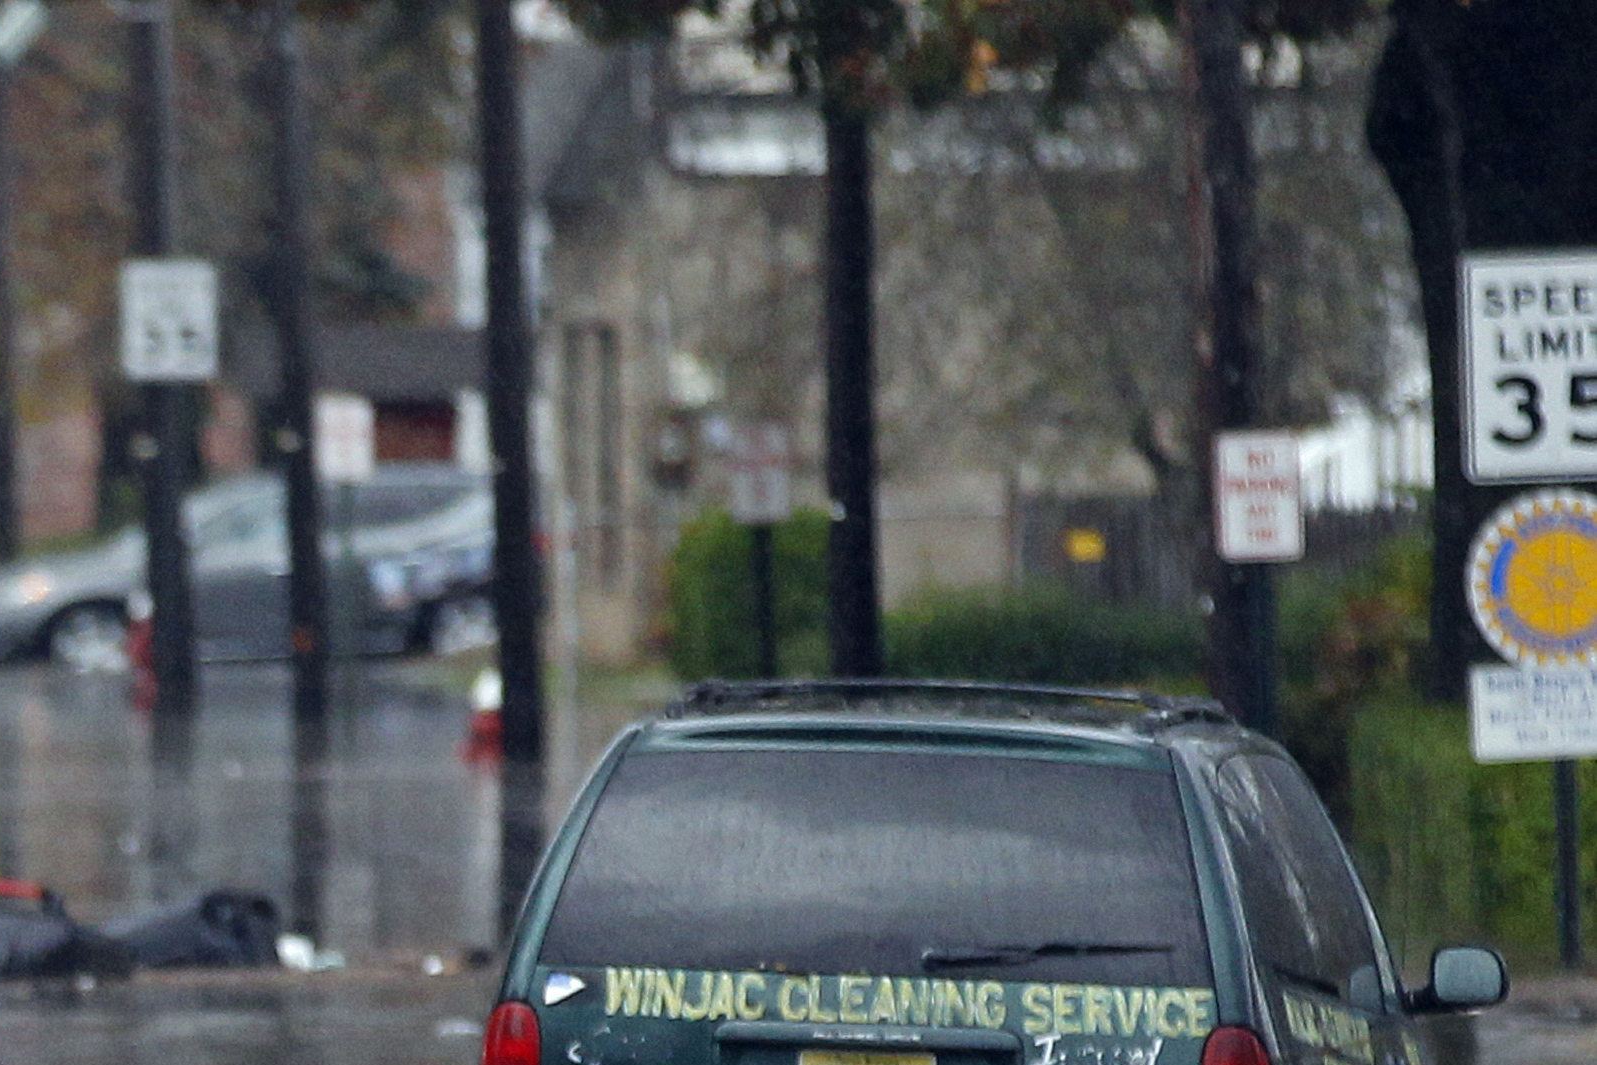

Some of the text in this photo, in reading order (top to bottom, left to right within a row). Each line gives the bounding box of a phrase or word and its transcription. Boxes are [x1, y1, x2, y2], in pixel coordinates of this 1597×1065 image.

[1484, 283, 1597, 317] SPEE
[1497, 325, 1597, 361] LIMI
[1492, 374, 1597, 444] 35
[605, 966, 1215, 1038] WINJAC CLEANING SERVICE
